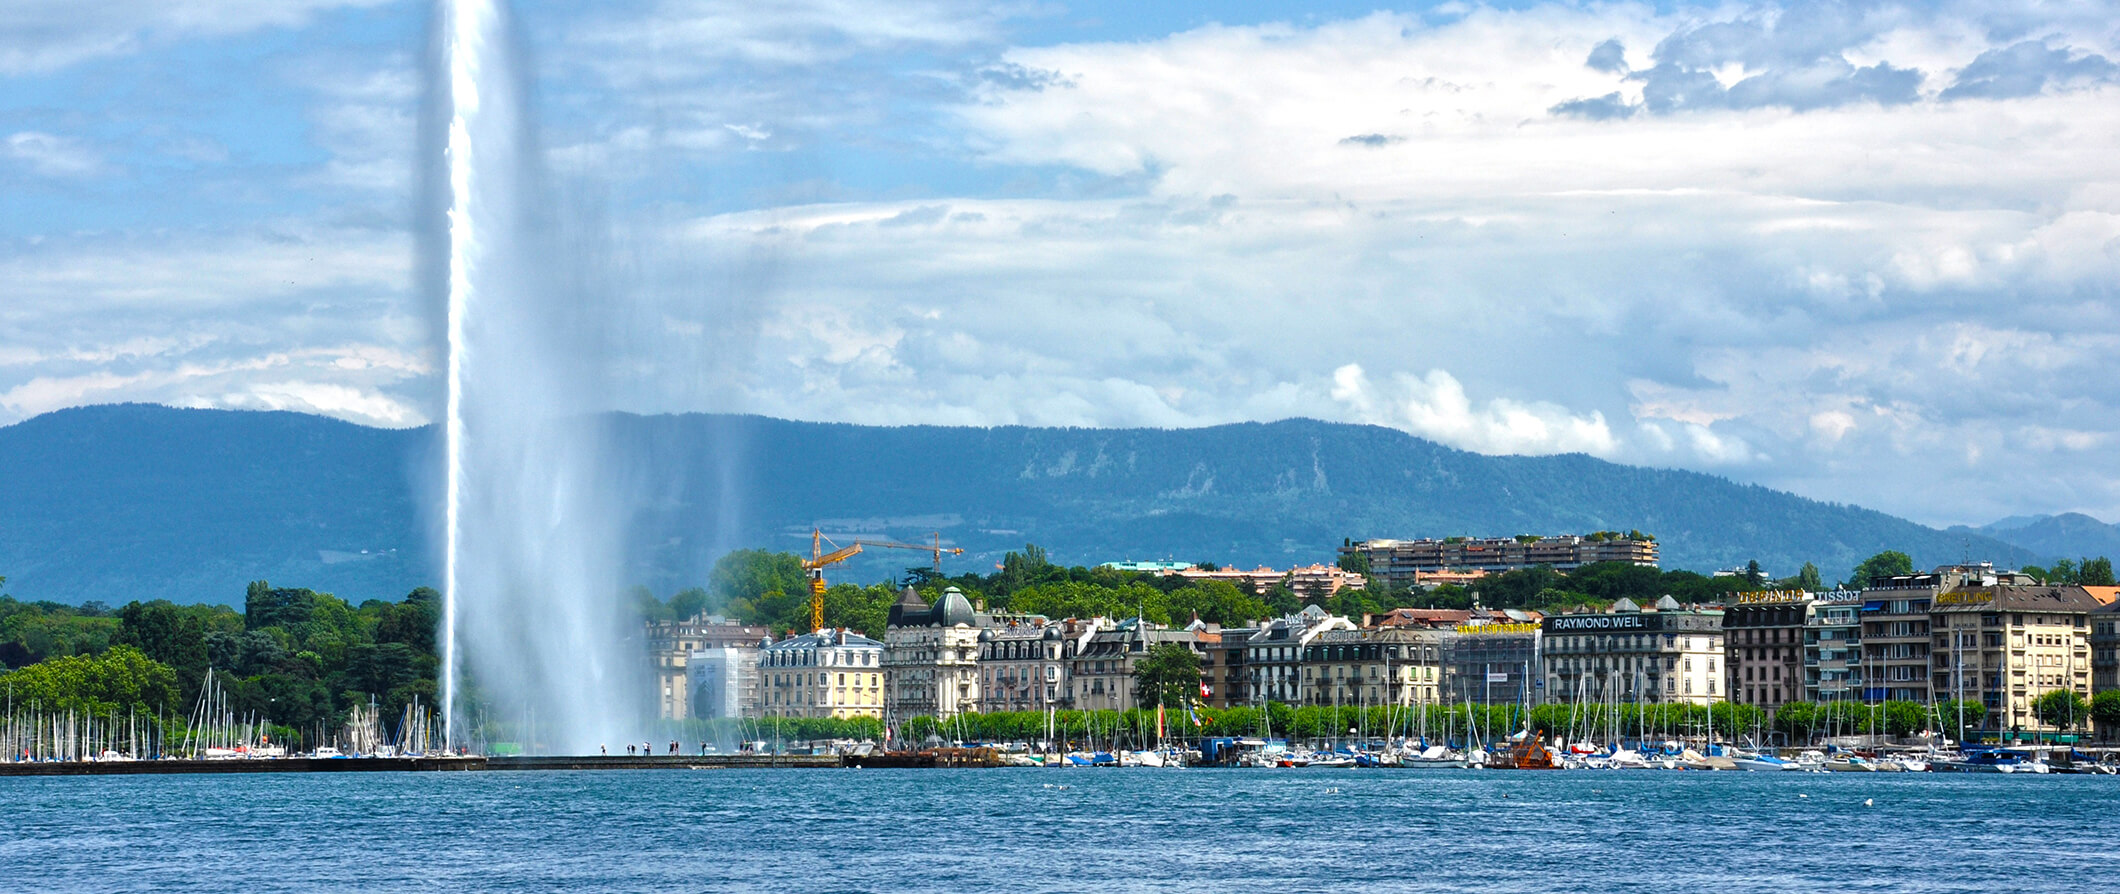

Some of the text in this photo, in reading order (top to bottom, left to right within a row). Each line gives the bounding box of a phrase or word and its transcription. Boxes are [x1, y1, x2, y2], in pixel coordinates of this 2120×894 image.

[1816, 591, 1860, 602] TISSOT
[1936, 592, 1993, 604] BREITLING
[1555, 616, 1642, 630] RAYMOND WEIL
